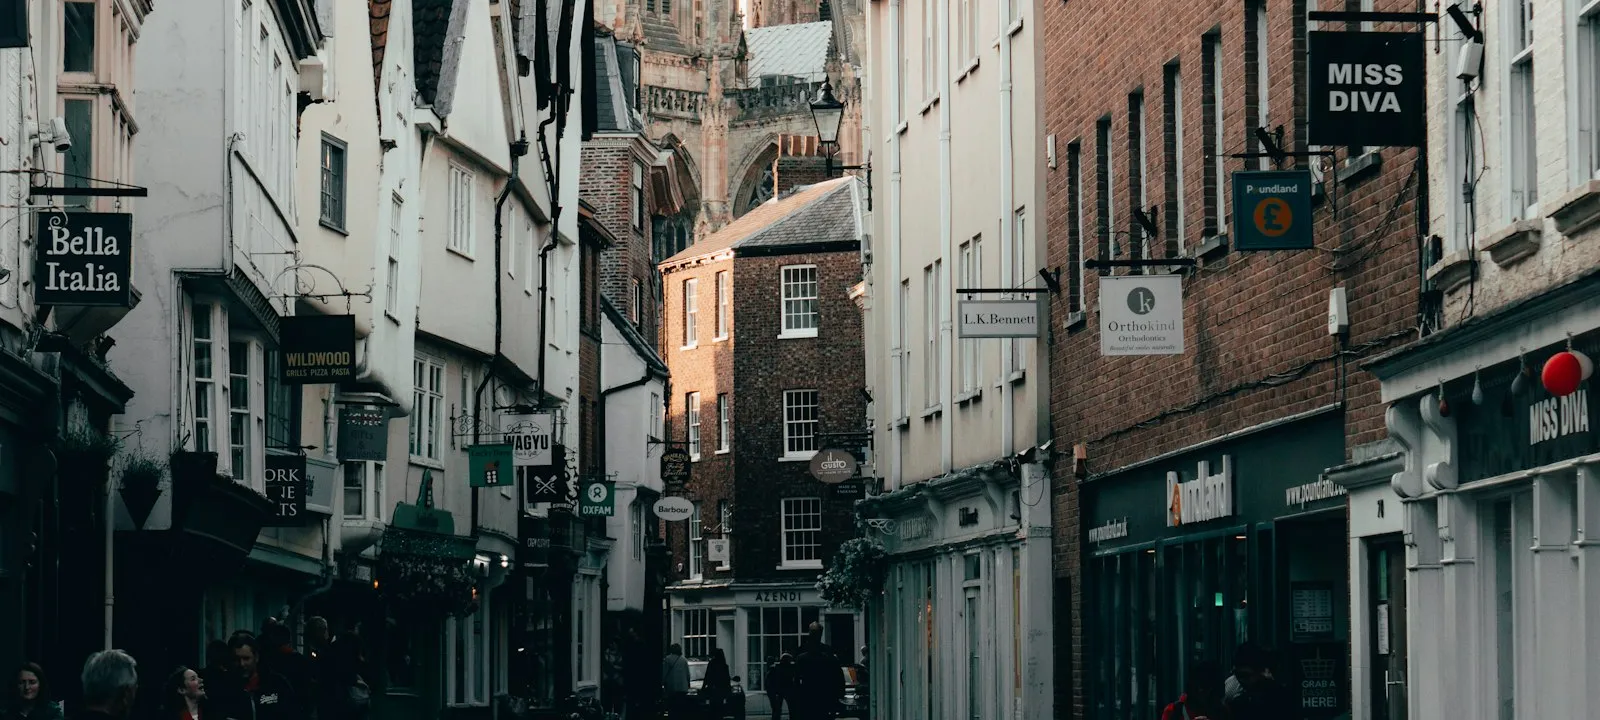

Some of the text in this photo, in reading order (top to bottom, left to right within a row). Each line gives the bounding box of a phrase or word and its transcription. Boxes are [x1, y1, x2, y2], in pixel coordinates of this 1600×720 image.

[1328, 63, 1403, 85] MISS
[1329, 91, 1401, 112] DIVA
[46, 226, 120, 256] Bella
[45, 262, 121, 291] Italia
[965, 313, 1035, 325] L.K.Bennett
[1108, 320, 1175, 332] Orthokind
[286, 352, 350, 367] WILDWOOD
[286, 369, 307, 377] GRILLS
[331, 368, 350, 376] PASTA
[1529, 389, 1589, 446] MISS DIVA
[504, 434, 549, 450] WAGYU
[265, 468, 301, 482] ORK
[582, 505, 612, 515] OXFAM
[658, 506, 688, 514] Barbour
[755, 591, 802, 602] AZENDI
[1301, 680, 1336, 688] GRAB A
[1301, 697, 1337, 709] HERE!
